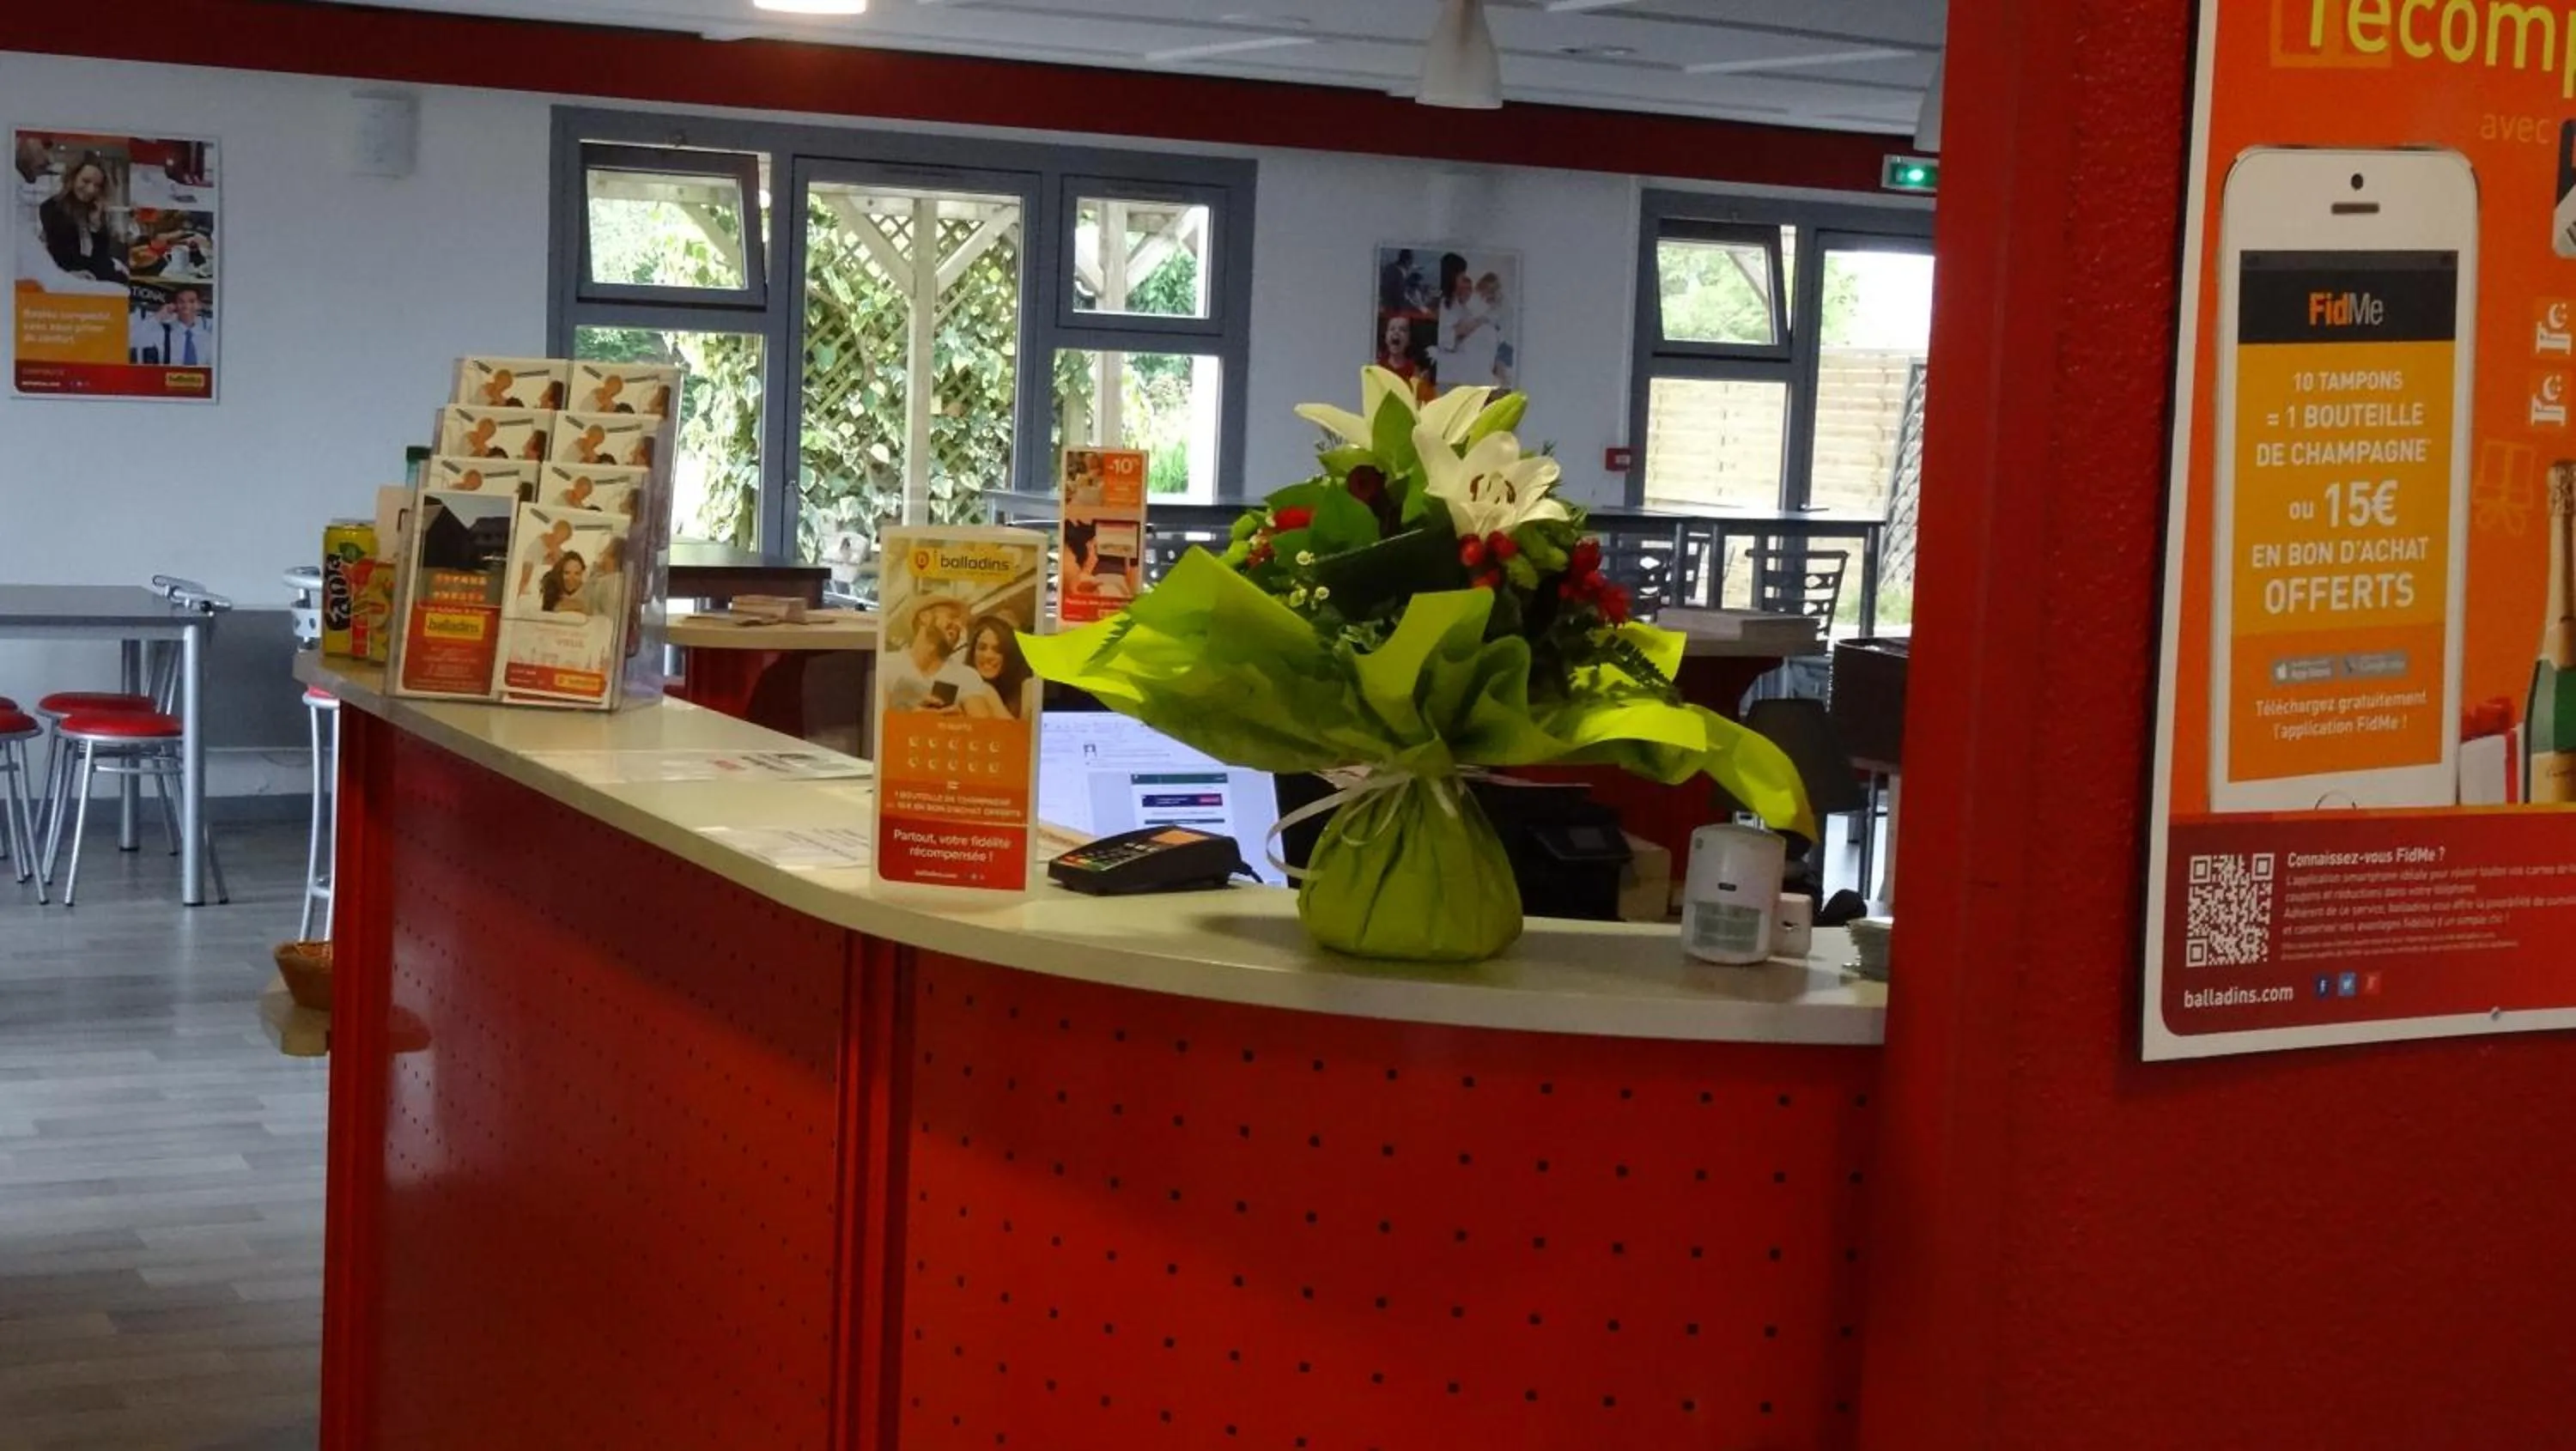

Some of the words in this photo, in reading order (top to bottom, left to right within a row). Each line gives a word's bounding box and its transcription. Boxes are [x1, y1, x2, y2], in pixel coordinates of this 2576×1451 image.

[2481, 113, 2552, 143] avec
[2309, 293, 2384, 326] FidMe
[2293, 372, 2314, 392] 10
[2319, 371, 2403, 392] TAMPONS
[2286, 405, 2296, 428] 1
[2304, 403, 2424, 428] BOUTEILLE
[2257, 443, 2286, 467] DE
[2324, 479, 2398, 528] 15€
[940, 555, 1010, 571] balladins
[2251, 544, 2281, 568] EN
[2287, 542, 2334, 567] BON
[2340, 536, 2429, 564] D'ACHAT
[2264, 572, 2415, 615] OFFERTS
[2255, 697, 2336, 717] Téléchargez
[2338, 689, 2427, 713] gratuitement
[2357, 714, 2399, 732] FidMe
[894, 829, 937, 845] Partout,
[939, 835, 969, 846] votre
[2287, 851, 2393, 867] Connaissez-vous
[2396, 847, 2436, 863] FidMe
[2183, 987, 2294, 1008] balladins.com
